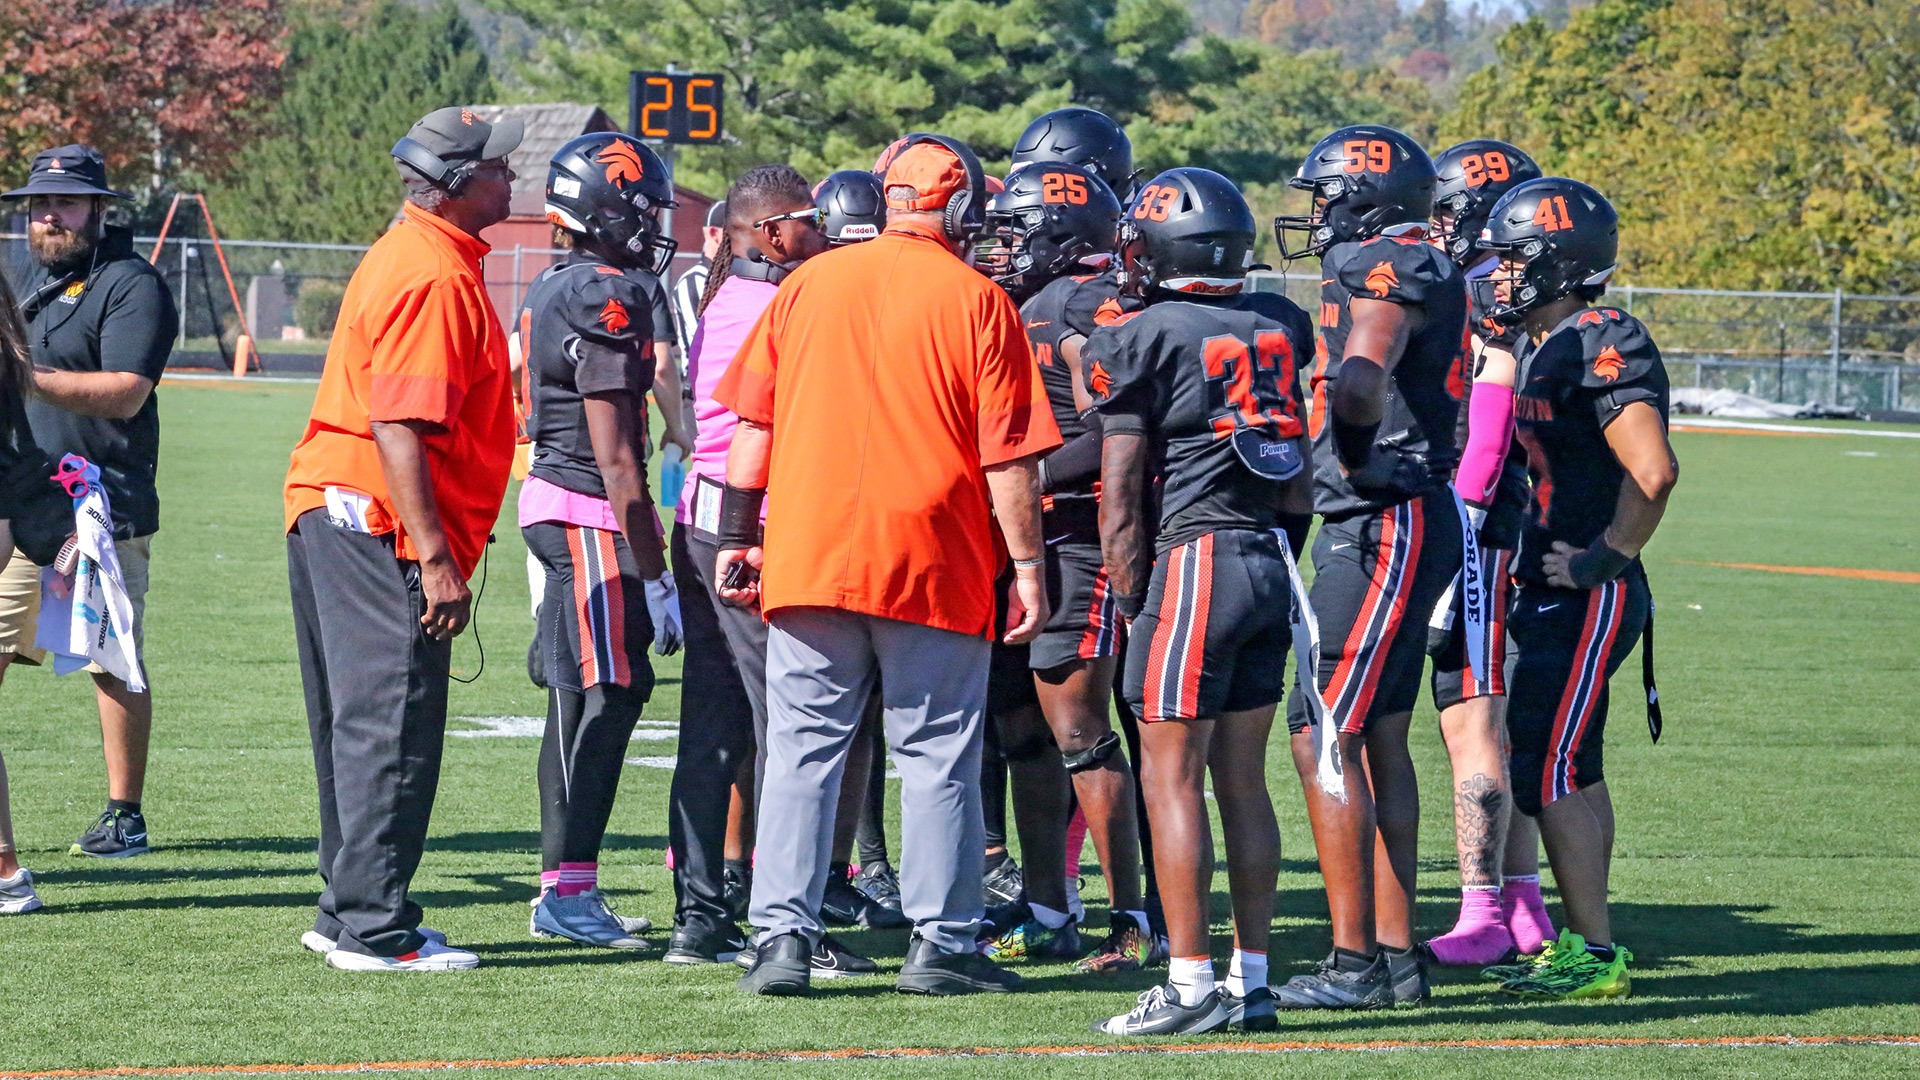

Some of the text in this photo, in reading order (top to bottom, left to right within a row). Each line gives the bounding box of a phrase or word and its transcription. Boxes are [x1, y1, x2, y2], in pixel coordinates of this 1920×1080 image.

[641, 77, 717, 138] 25
[1343, 140, 1391, 174] 59
[1460, 151, 1510, 188] 29
[1041, 172, 1088, 205] 25
[1134, 184, 1179, 222] 33
[845, 226, 875, 234] Riddell
[1532, 195, 1573, 232] 41
[1200, 330, 1304, 442] 33
[1465, 529, 1480, 626] ORADE
